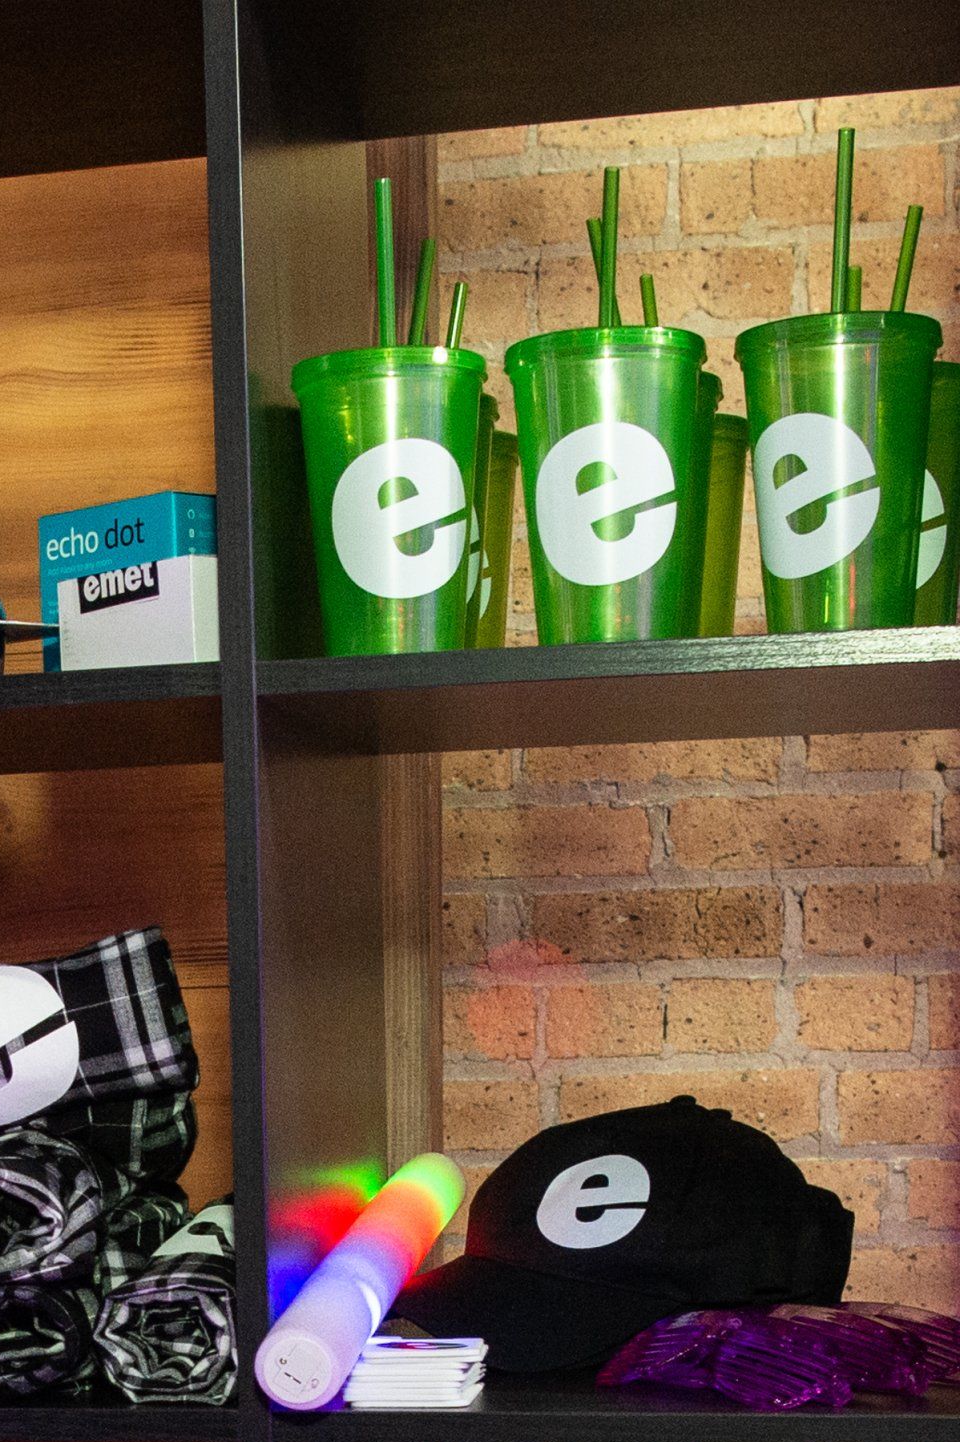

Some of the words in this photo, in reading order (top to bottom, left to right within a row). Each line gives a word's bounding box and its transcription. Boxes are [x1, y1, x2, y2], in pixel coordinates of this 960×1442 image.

[46, 527, 99, 560] echo
[104, 518, 145, 549] dot
[332, 438, 467, 599] e
[536, 421, 677, 586] e
[754, 412, 881, 579] e
[83, 561, 155, 602] emet
[536, 1154, 651, 1249] e
